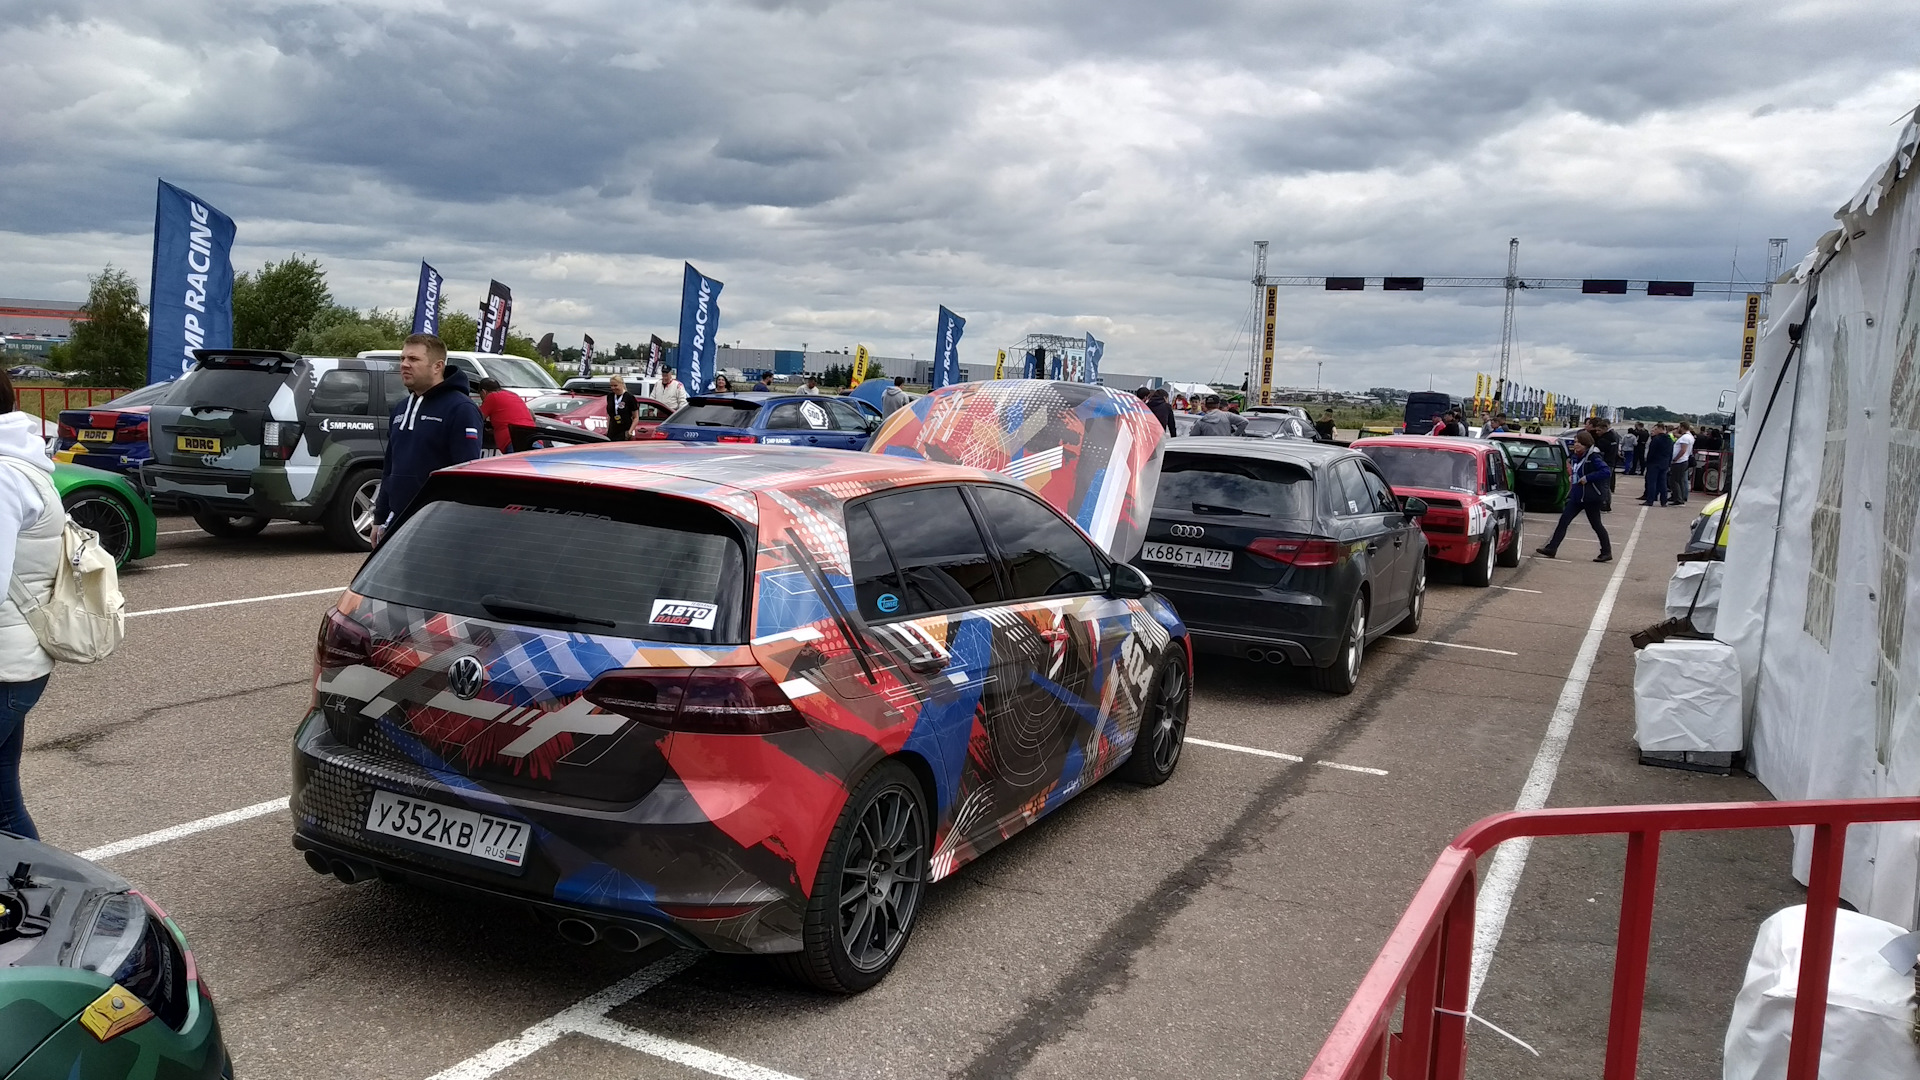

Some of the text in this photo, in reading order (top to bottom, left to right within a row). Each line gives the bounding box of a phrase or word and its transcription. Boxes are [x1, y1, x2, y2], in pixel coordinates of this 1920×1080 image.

[184, 201, 213, 313] RACING
[425, 268, 437, 320] RACING
[1268, 288, 1276, 316] RDRC
[1747, 297, 1758, 329] RDRC
[691, 278, 711, 393] SMP RACING
[1266, 323, 1274, 351] RDRC
[1743, 337, 1754, 368] RDRC
[1264, 357, 1272, 384] RDRC
[83, 430, 107, 440] RDRC
[330, 422, 375, 430] SMP RACING
[185, 438, 214, 450] RDRC
[1206, 550, 1230, 564] 777
[654, 615, 690, 624] ПЛЮС
[660, 605, 709, 619] АВТО
[480, 818, 522, 849] 777
[484, 846, 505, 859] RUS
